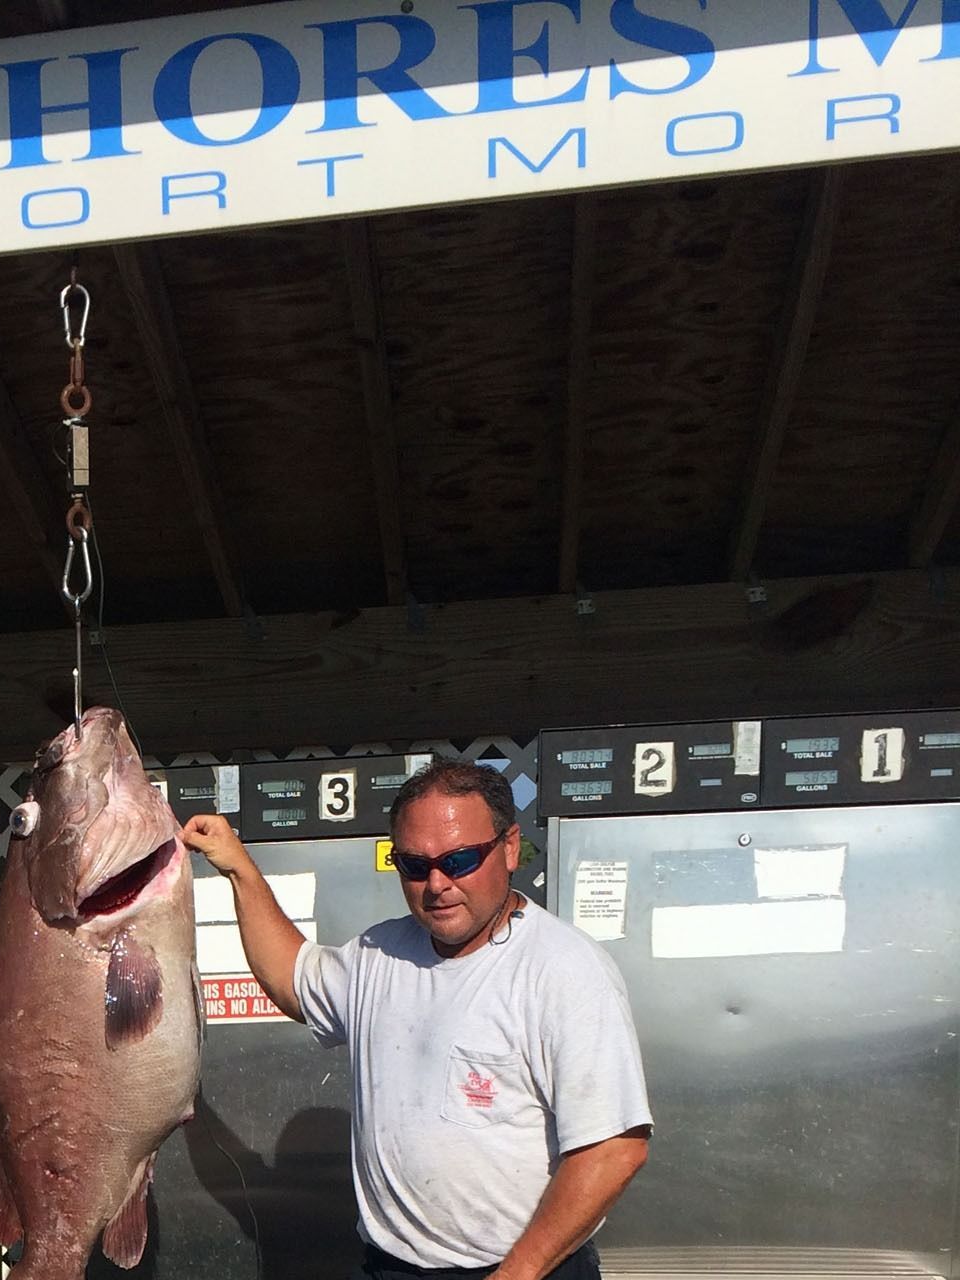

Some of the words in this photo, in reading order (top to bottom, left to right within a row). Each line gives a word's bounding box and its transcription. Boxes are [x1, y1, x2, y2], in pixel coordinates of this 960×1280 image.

[488, 93, 901, 180] MOR
[640, 748, 668, 787] 2
[872, 733, 891, 778] 1
[326, 777, 350, 816] 3
[224, 982, 266, 999] GASOL
[231, 999, 248, 1015] NO
